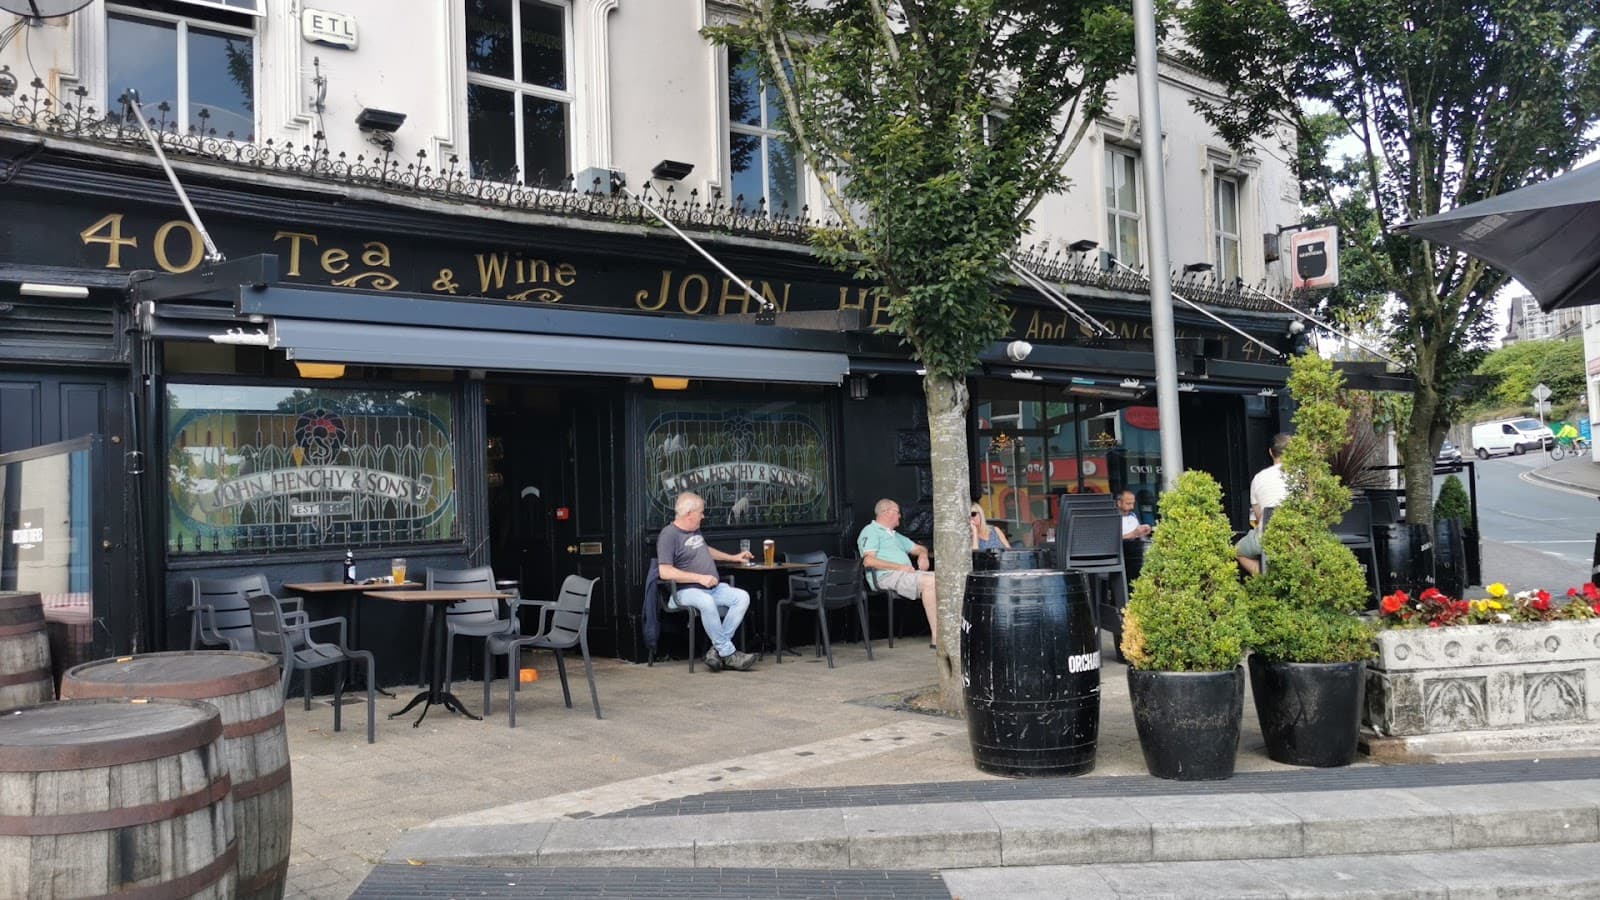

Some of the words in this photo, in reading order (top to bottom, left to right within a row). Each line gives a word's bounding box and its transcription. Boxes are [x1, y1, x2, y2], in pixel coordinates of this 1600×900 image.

[312, 14, 353, 36] ETL
[80, 213, 205, 274] 40
[273, 231, 391, 277] Tea
[432, 268, 460, 294] &
[475, 251, 577, 293] Wine
[634, 270, 792, 315] JOHN
[1025, 308, 1068, 340] And
[213, 476, 267, 507] JOHN
[273, 469, 346, 492] HENCHY
[351, 470, 361, 489] &
[367, 472, 410, 498] SONS
[710, 463, 756, 482] HENCHY
[759, 465, 766, 480] &
